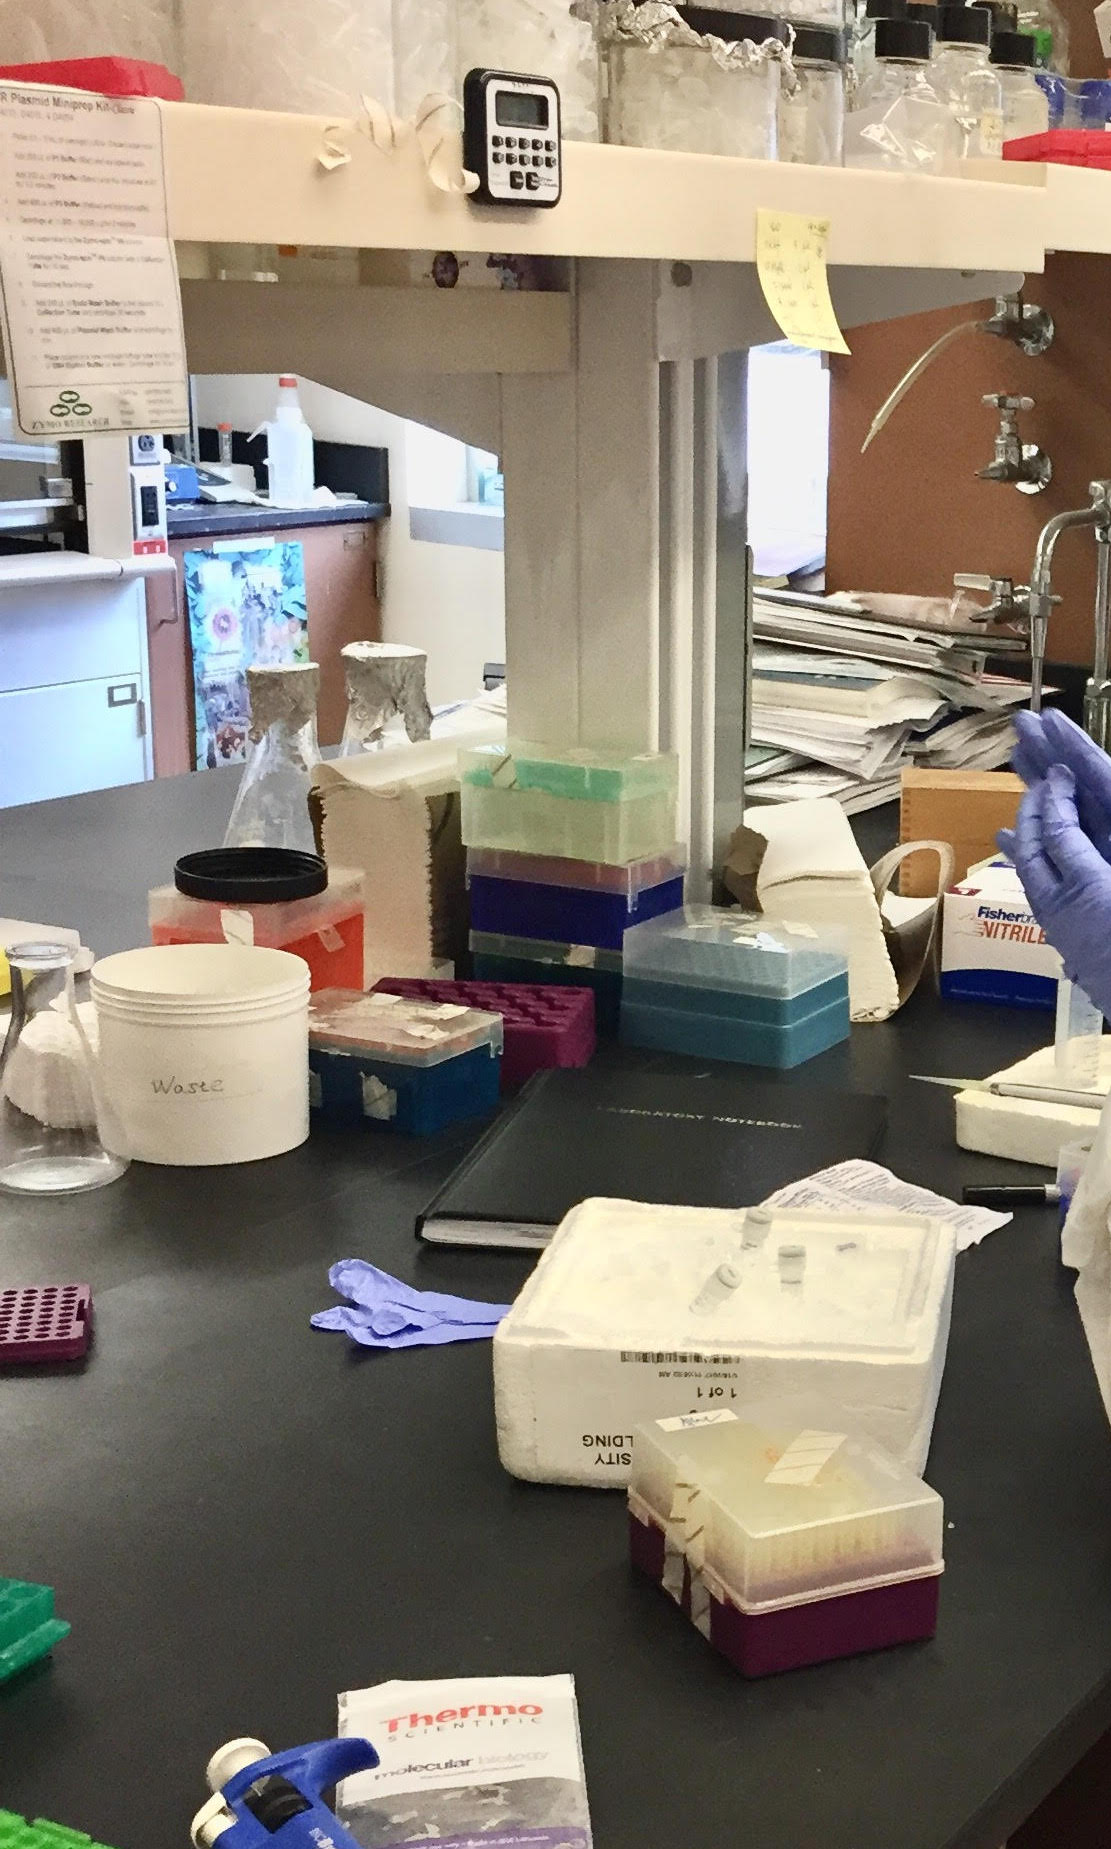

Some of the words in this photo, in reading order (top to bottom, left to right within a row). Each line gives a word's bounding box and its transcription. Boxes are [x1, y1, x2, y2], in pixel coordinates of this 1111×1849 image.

[151, 1075, 224, 1094] Waste
[712, 1115, 803, 1129] NOTEBOOK
[696, 1386, 704, 1399] 1
[709, 1386, 724, 1399] of
[730, 1387, 738, 1399] 1
[594, 1452, 632, 1466] SITY
[379, 1703, 544, 1734] Thermo
[387, 1716, 542, 1744] SCIENTIFIC
[374, 1757, 474, 1781] molecular
